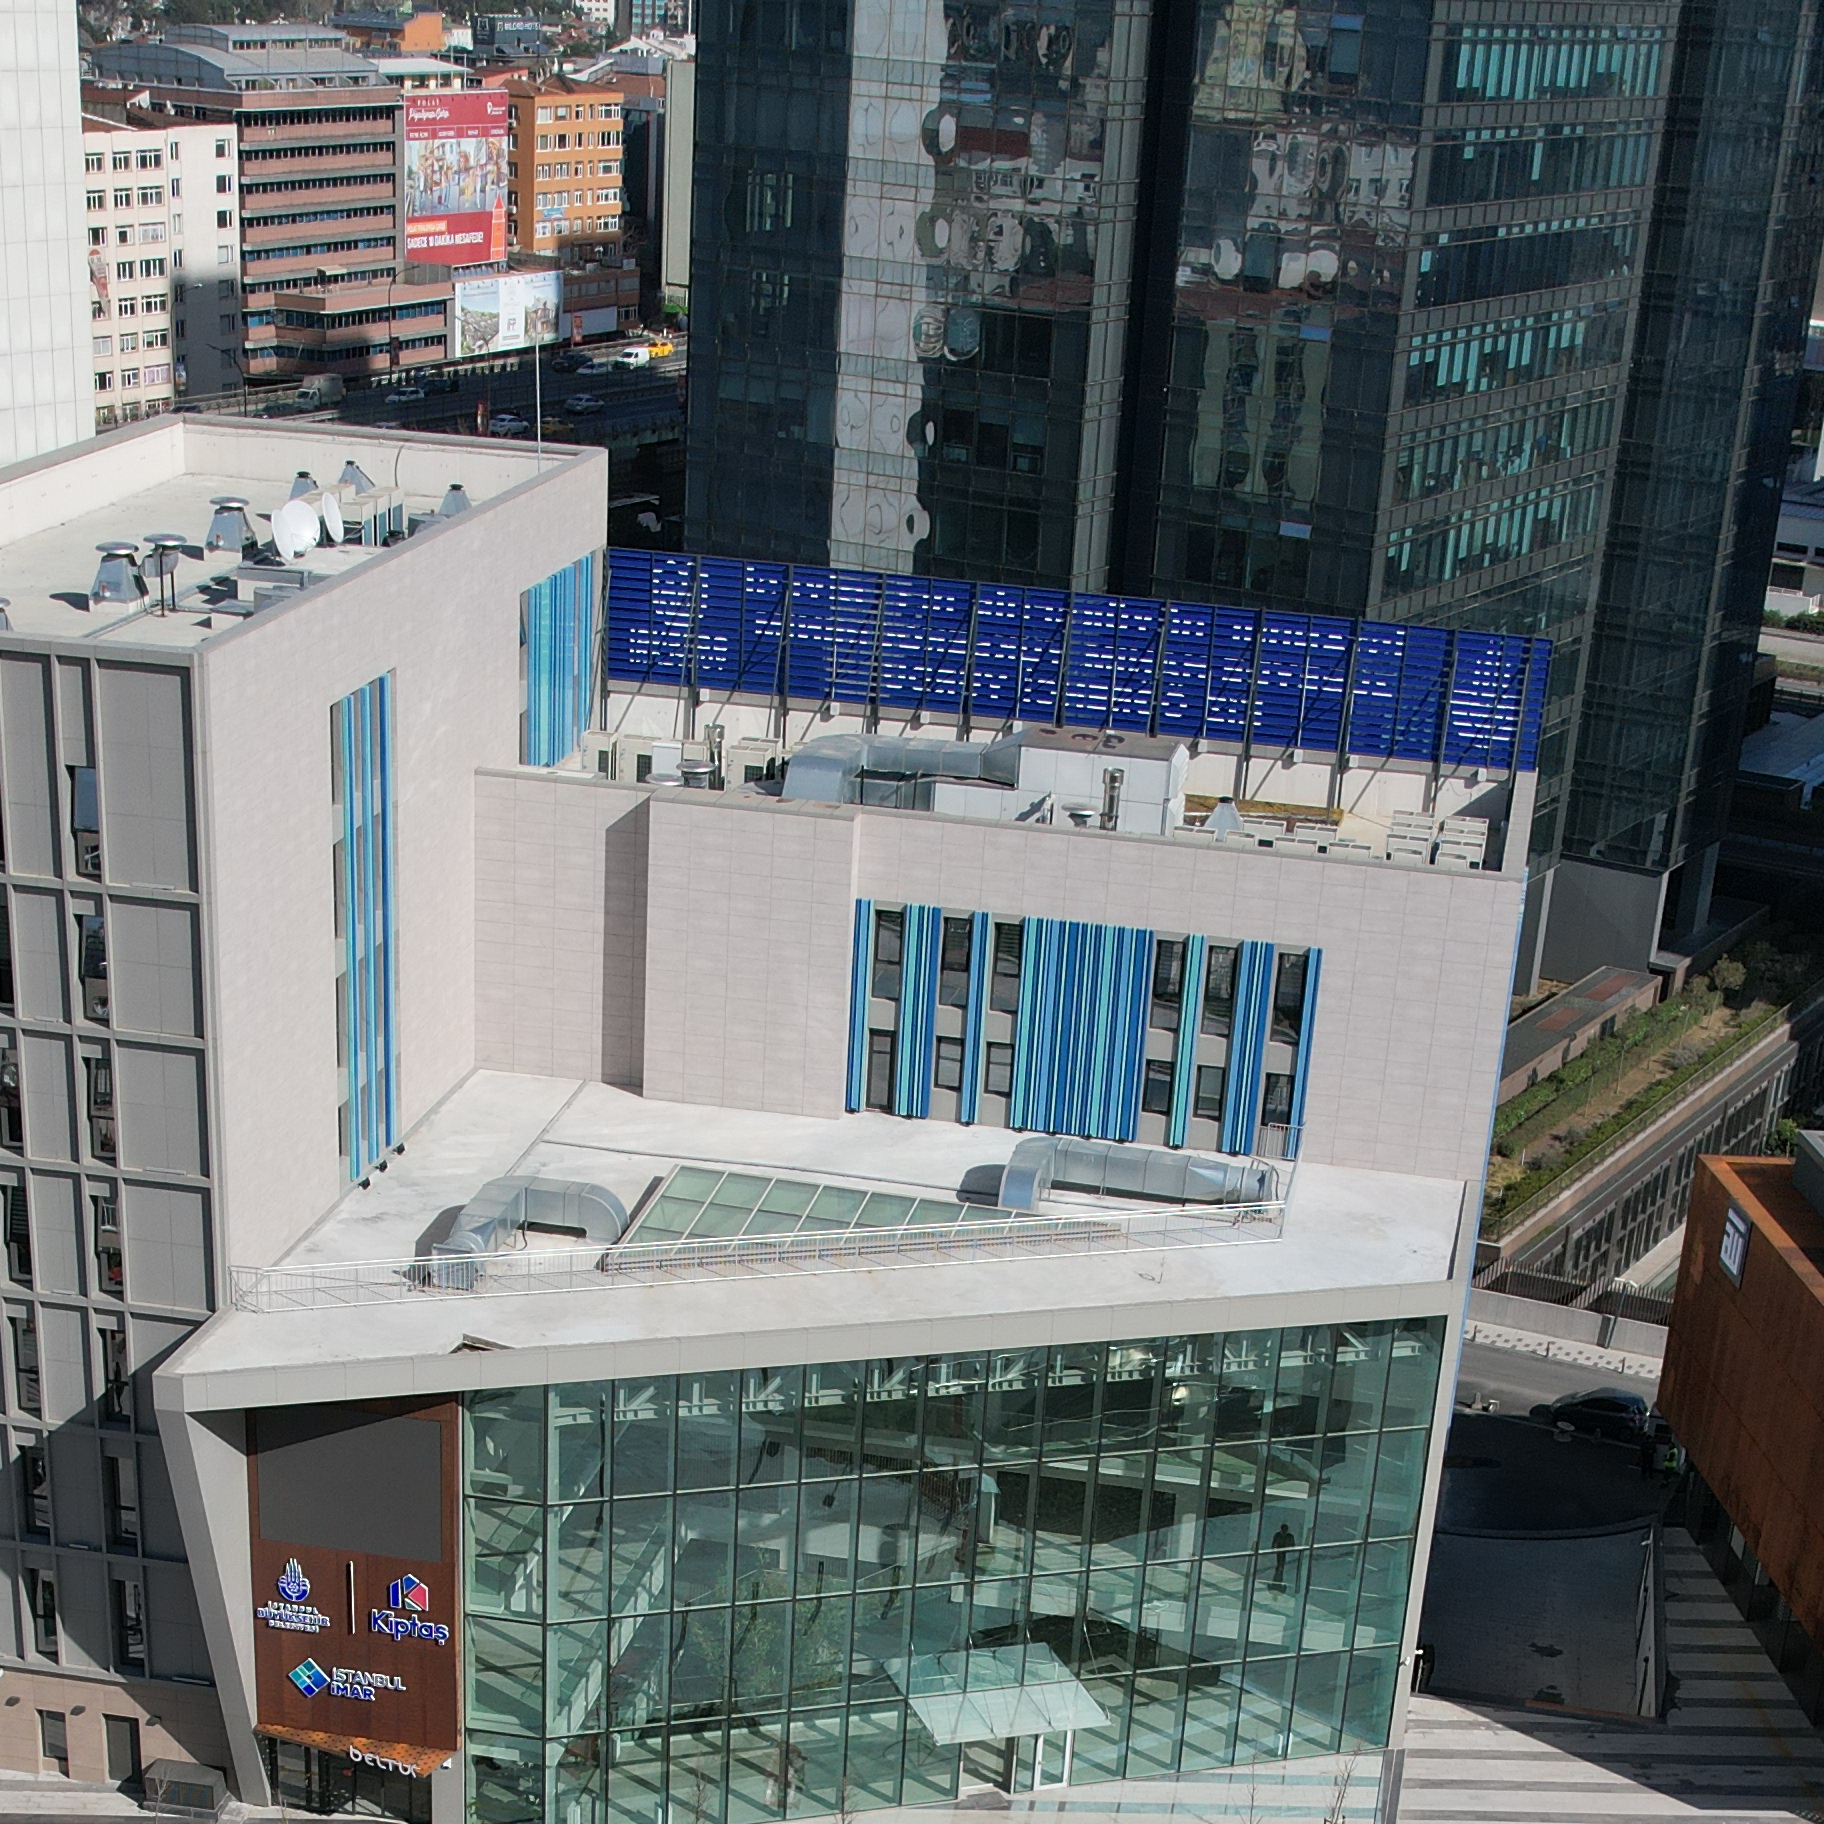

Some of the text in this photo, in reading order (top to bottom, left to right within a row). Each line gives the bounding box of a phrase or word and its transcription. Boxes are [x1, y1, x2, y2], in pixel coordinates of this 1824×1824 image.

[371, 1608, 450, 1646] Kiptaş
[332, 1666, 407, 1691] İSTANBUL
[330, 1682, 376, 1702] İMAR
